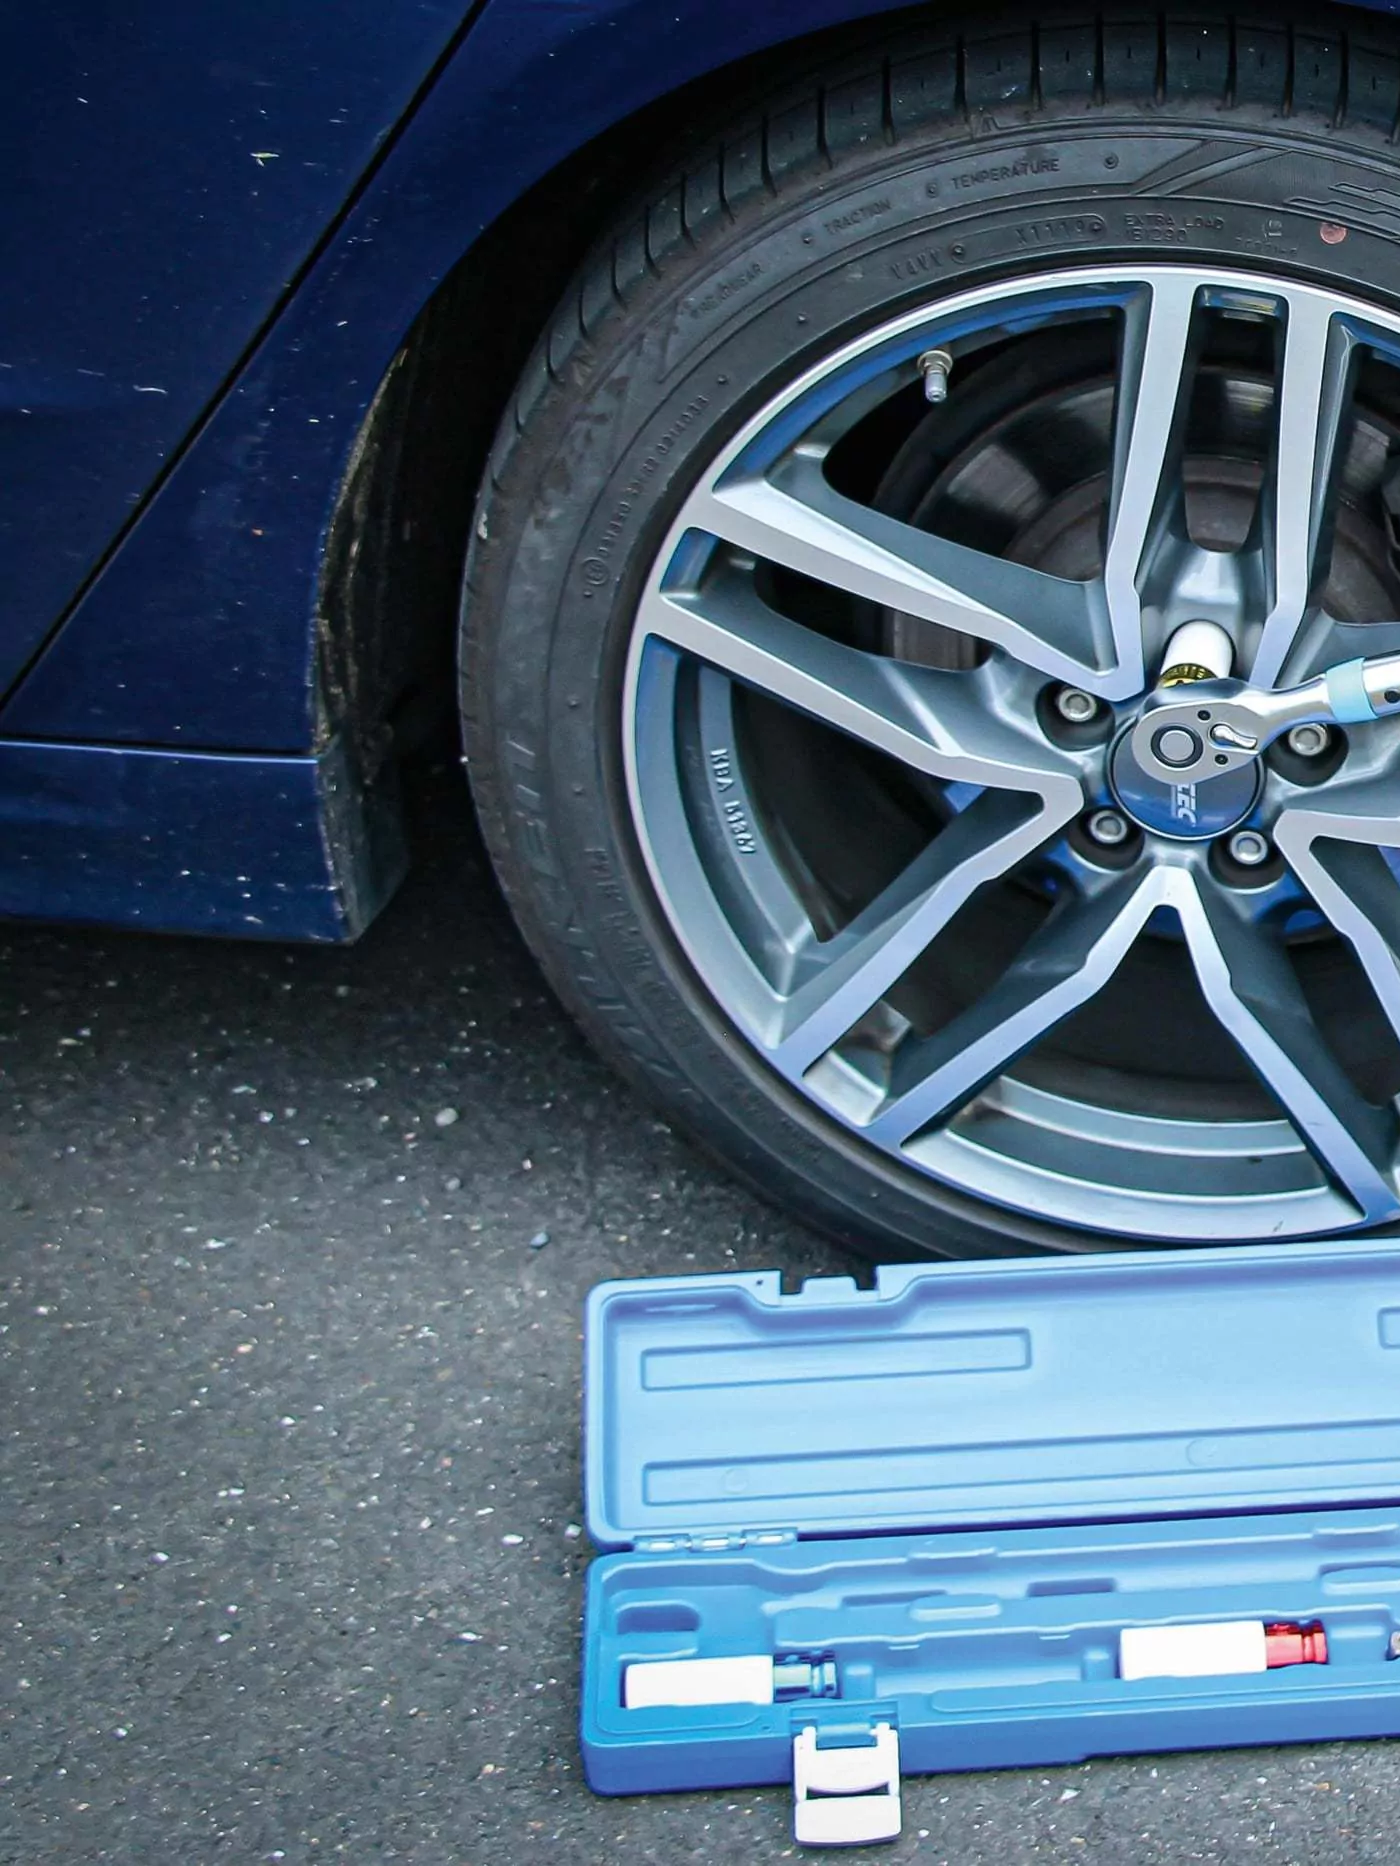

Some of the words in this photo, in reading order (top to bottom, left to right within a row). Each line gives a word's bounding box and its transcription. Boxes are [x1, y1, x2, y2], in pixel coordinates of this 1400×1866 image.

[951, 157, 1061, 191] TEMPERATURE
[822, 198, 894, 236] TRACTION
[1124, 212, 1175, 227] EXTRA
[710, 748, 734, 792] KBA
